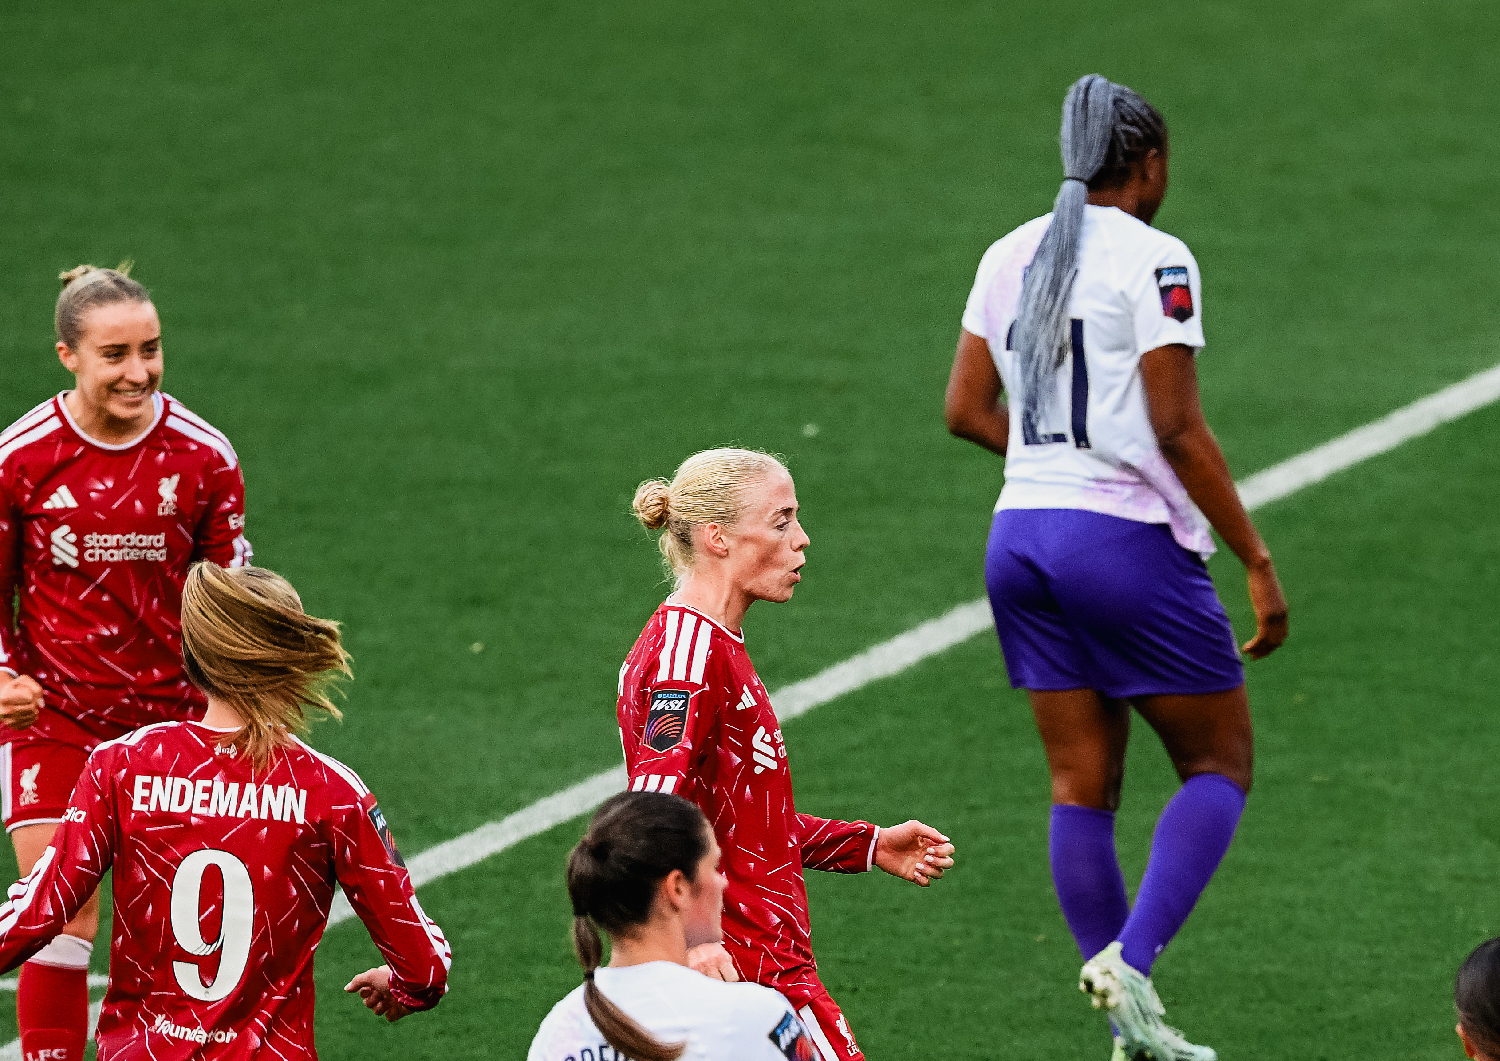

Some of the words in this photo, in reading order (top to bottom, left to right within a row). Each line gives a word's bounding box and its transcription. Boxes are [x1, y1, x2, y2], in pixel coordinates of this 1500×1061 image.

[83, 532, 165, 548] standard
[84, 548, 167, 562] chartered
[651, 699, 686, 710] WSL
[132, 775, 307, 824] ENDEMANN
[170, 848, 255, 1002] 9
